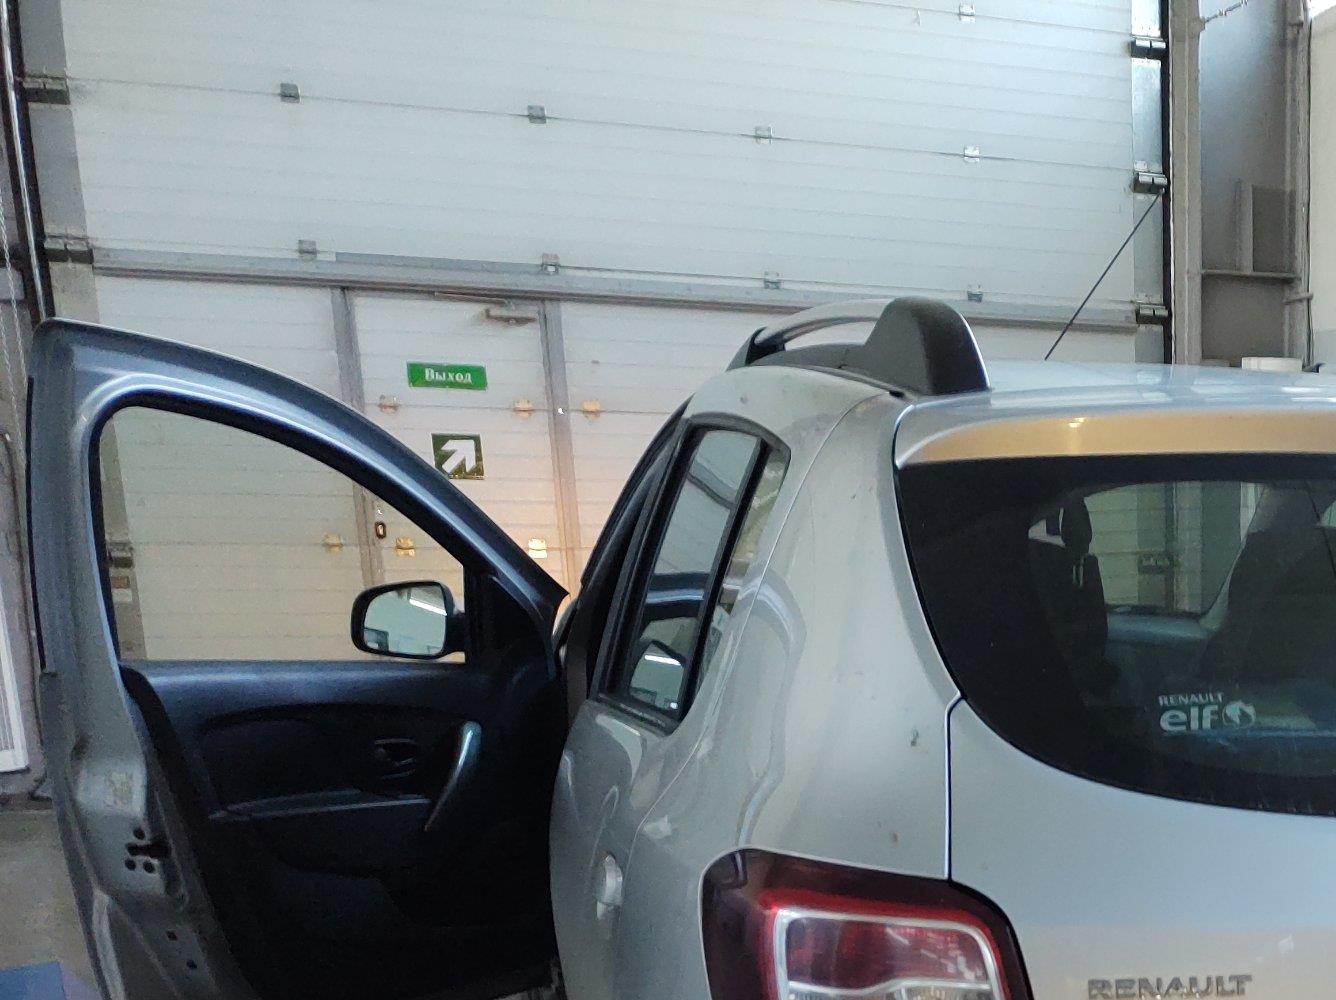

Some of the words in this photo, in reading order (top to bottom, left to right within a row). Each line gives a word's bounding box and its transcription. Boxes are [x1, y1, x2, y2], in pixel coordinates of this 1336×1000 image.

[425, 367, 473, 385] Выход
[1158, 692, 1224, 706] RENAULT
[1160, 705, 1219, 732] elf
[1087, 975, 1253, 1000] RENAULT
